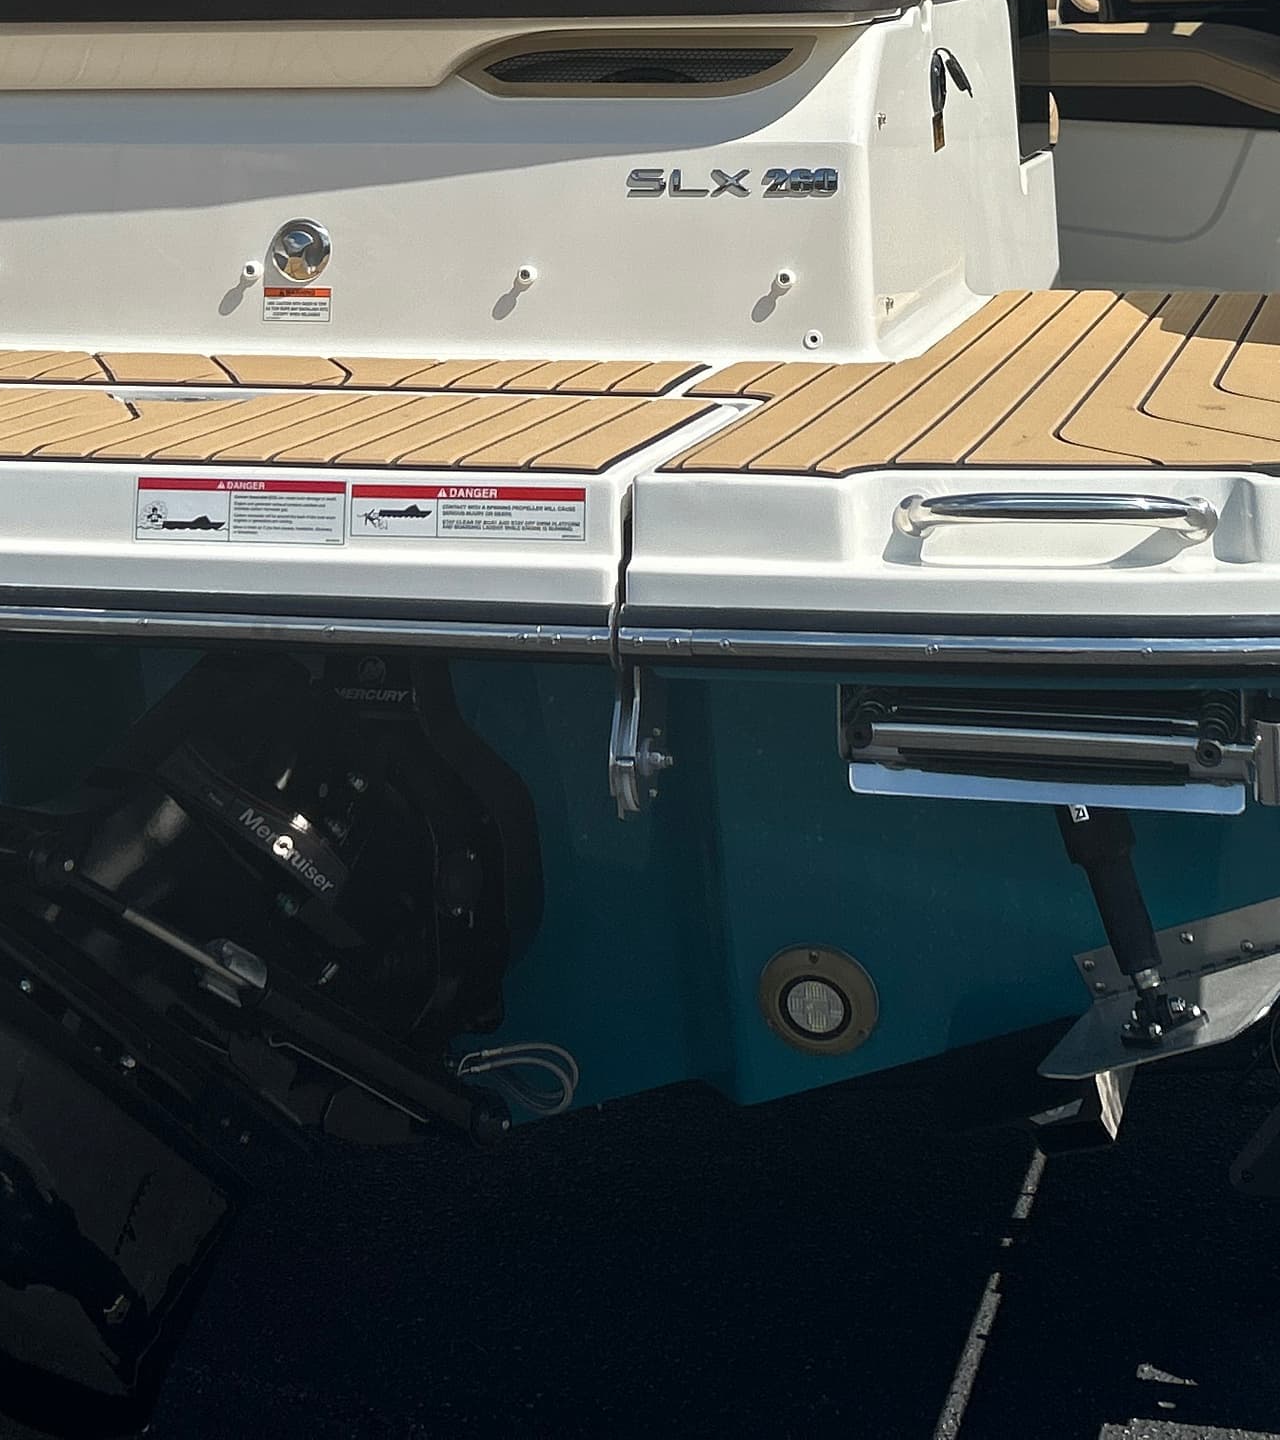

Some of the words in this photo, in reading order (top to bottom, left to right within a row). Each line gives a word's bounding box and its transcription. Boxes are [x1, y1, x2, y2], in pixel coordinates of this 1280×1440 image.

[626, 168, 752, 198] SLX
[761, 168, 839, 198] 260
[227, 481, 265, 490] DANGER
[449, 489, 498, 499] DANGER
[333, 687, 409, 703] MERCURY
[238, 807, 335, 892] MerCruiser
